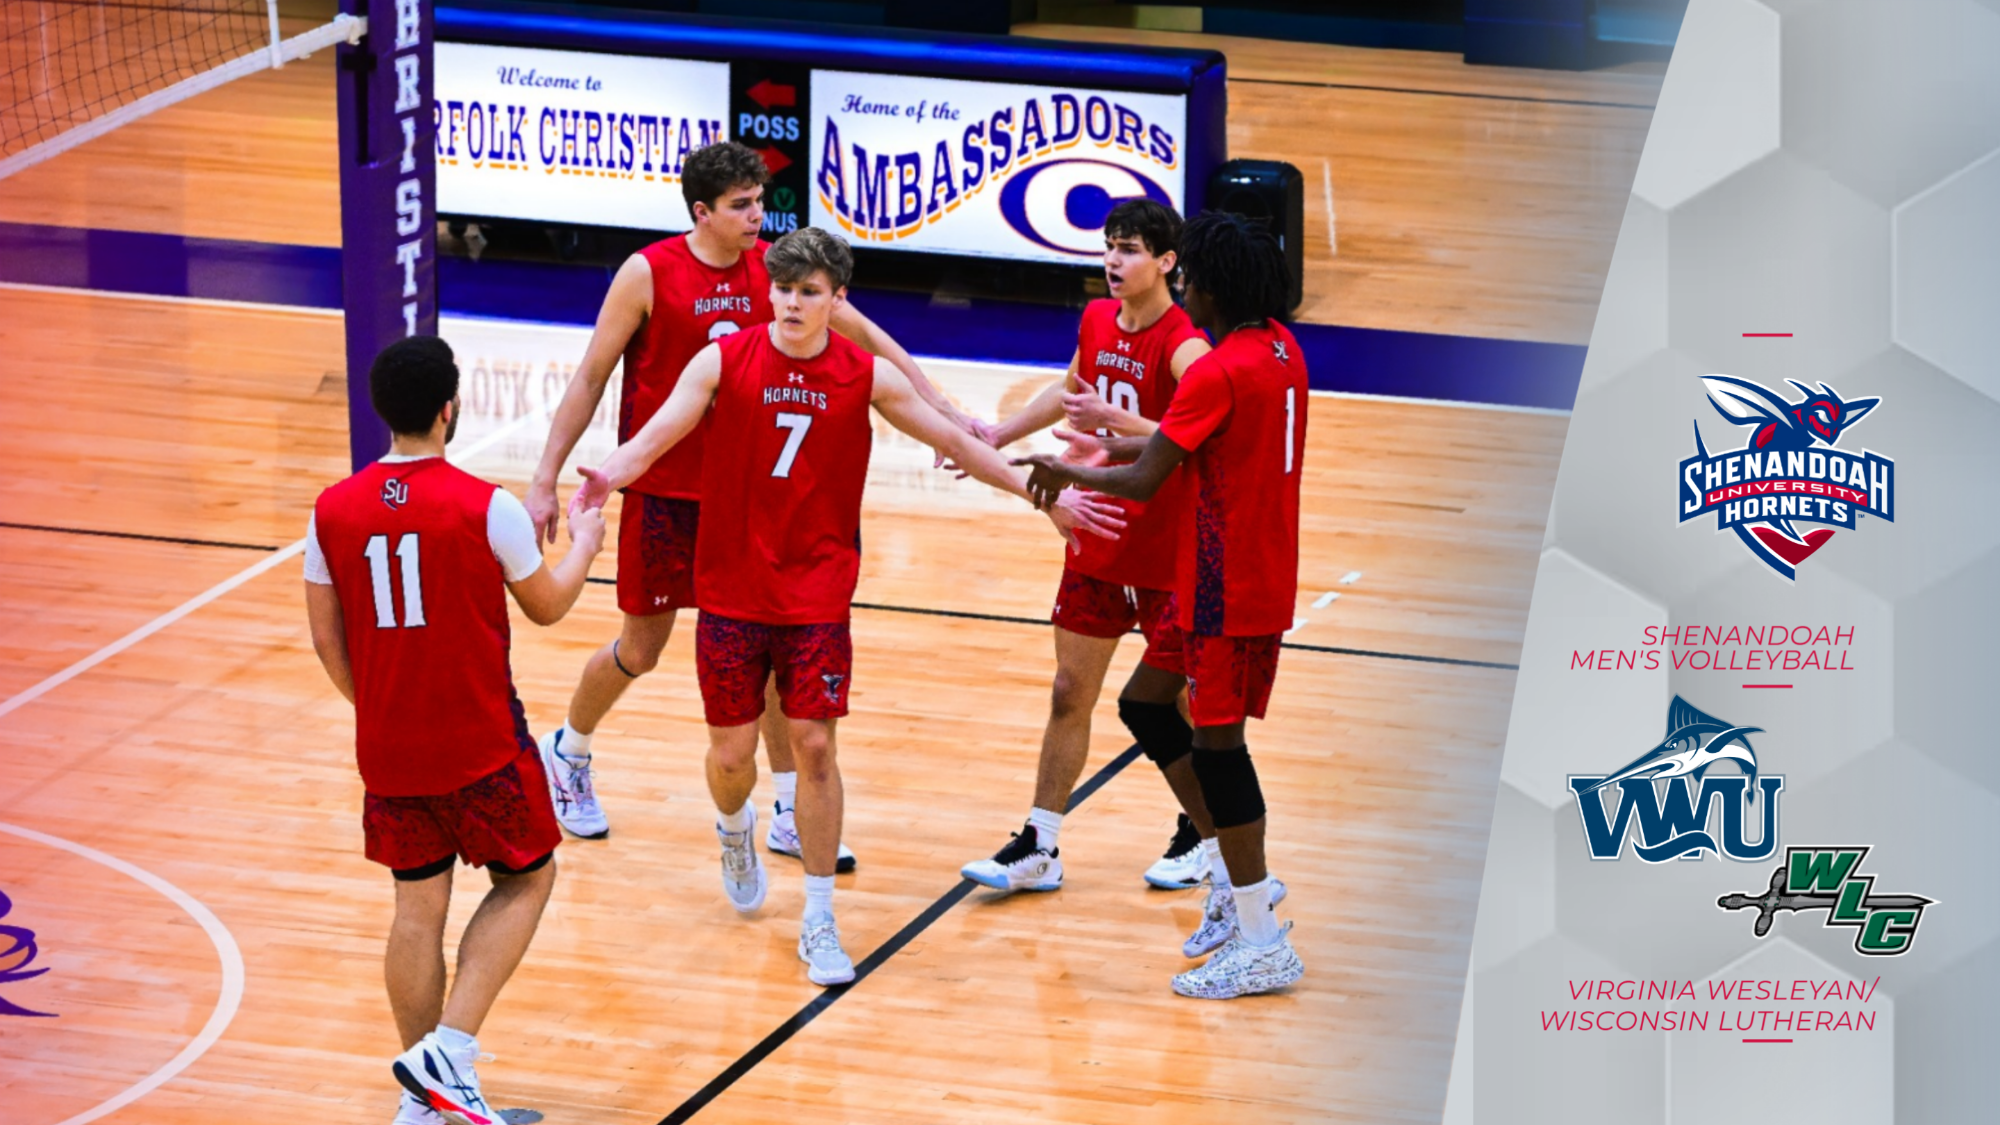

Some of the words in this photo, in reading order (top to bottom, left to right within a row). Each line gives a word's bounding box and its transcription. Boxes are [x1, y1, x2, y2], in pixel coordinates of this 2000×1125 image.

[497, 66, 580, 92] Welcome
[586, 75, 603, 93] to
[842, 94, 900, 118] Home
[905, 100, 927, 122] of
[932, 102, 960, 121] the
[739, 113, 799, 141] POSS
[817, 94, 1176, 236] AMBASSADORS
[694, 296, 751, 316] HORNETS
[1096, 350, 1145, 380] HORNETS
[763, 386, 827, 410] HORNETS
[1284, 385, 1295, 475] 1
[770, 412, 813, 478] 7
[384, 478, 409, 504] SU
[363, 532, 428, 628] 11
